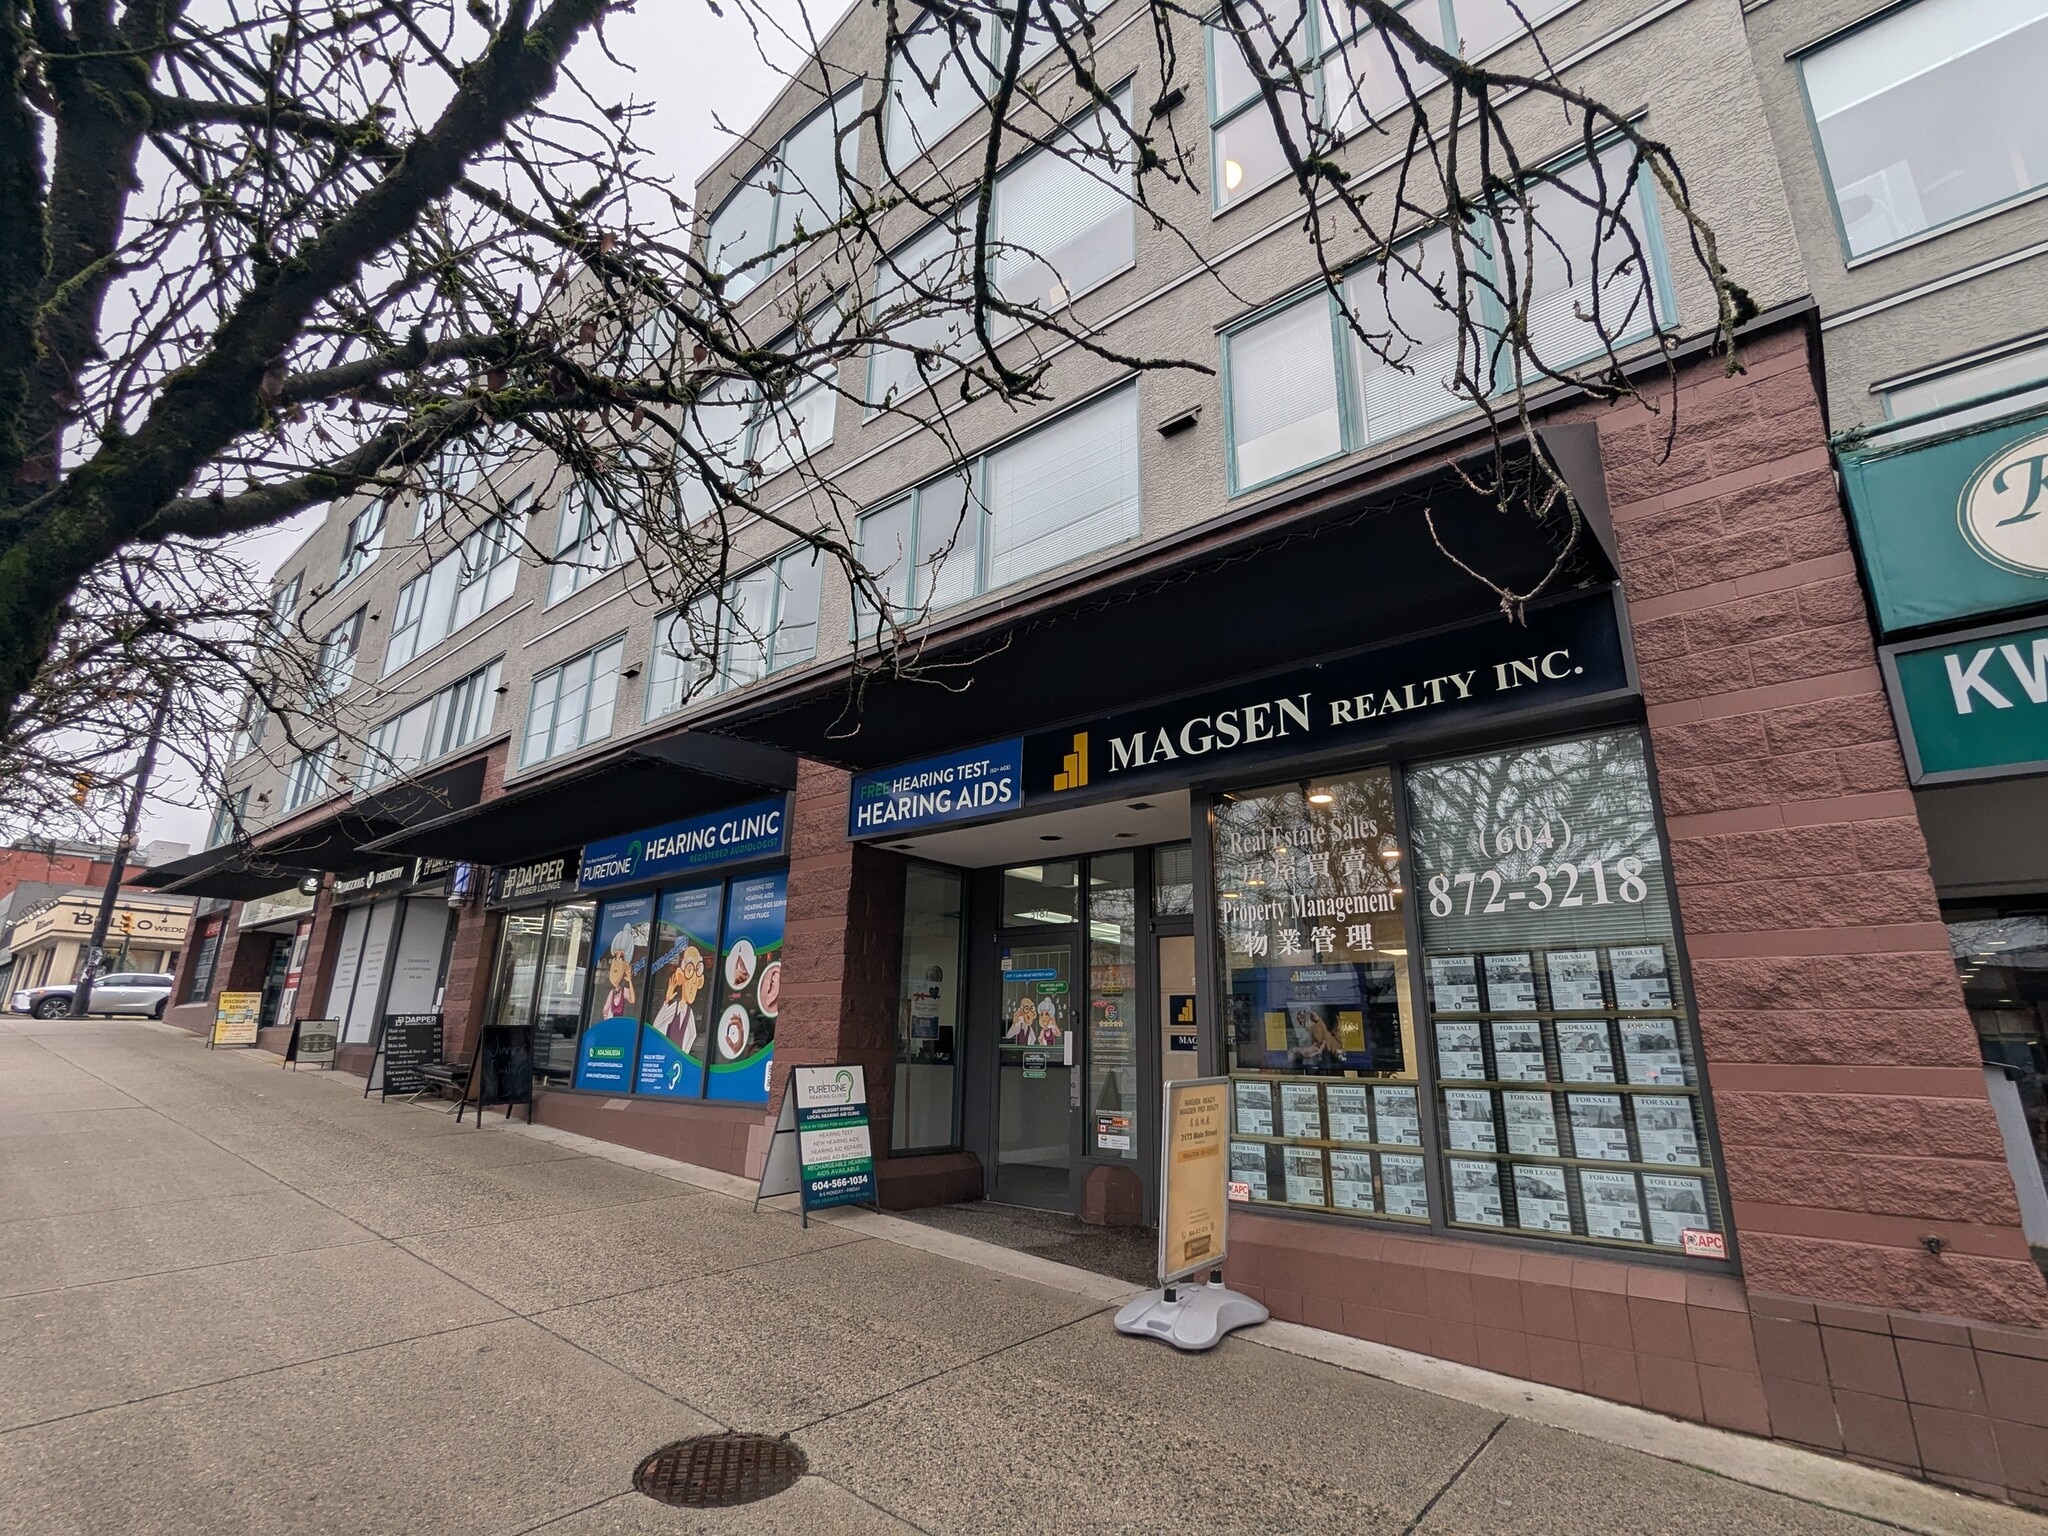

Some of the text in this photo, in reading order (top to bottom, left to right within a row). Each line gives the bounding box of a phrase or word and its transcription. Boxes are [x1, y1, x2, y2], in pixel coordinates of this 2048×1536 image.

[1108, 648, 1583, 772] MAGSEN REALTY INC.
[861, 781, 890, 800] FREE
[893, 768, 954, 793] HEARING
[957, 760, 990, 780] TEST
[858, 778, 1012, 827] HEARING AIDS
[645, 811, 780, 861] HEARING CLINIC
[1230, 815, 1379, 854] Real Estate Sales
[1479, 817, 1571, 858] (604)
[689, 837, 779, 864] REGISTERED AUDIOLOGIST
[582, 857, 632, 882] PURETONE
[1243, 846, 1366, 883] 房屋買賣
[516, 858, 565, 889] DAPPER
[514, 880, 562, 897] BARBER LOUNGE
[746, 884, 764, 892] HEARING
[1428, 857, 1647, 917] 872-3218
[745, 893, 763, 901] HEARING
[744, 902, 762, 911] HEARING
[763, 901, 773, 909] AIDS
[1222, 890, 1397, 929] Property Management
[72, 912, 152, 930] BLO
[743, 911, 770, 920] NOISE PLUGS
[1244, 923, 1374, 958] 物業管理
[808, 1083, 846, 1094] PURETONE
[818, 1130, 841, 1138] HEARING
[1181, 1133, 1192, 1141] 3173
[808, 1155, 831, 1163] HEARING
[842, 1151, 867, 1159] BATTERIES
[810, 1147, 833, 1155] HEARING
[807, 1158, 869, 1171] RECHARGEABLE HEARING
[830, 1165, 860, 1176] AVAILABLE
[1535, 1169, 1558, 1177] LEASE
[812, 1174, 868, 1191] 604-566-1034
[1234, 1185, 1247, 1194] APC
[1650, 1178, 1694, 1188] FOR LEASE
[1699, 1235, 1722, 1249] APC
